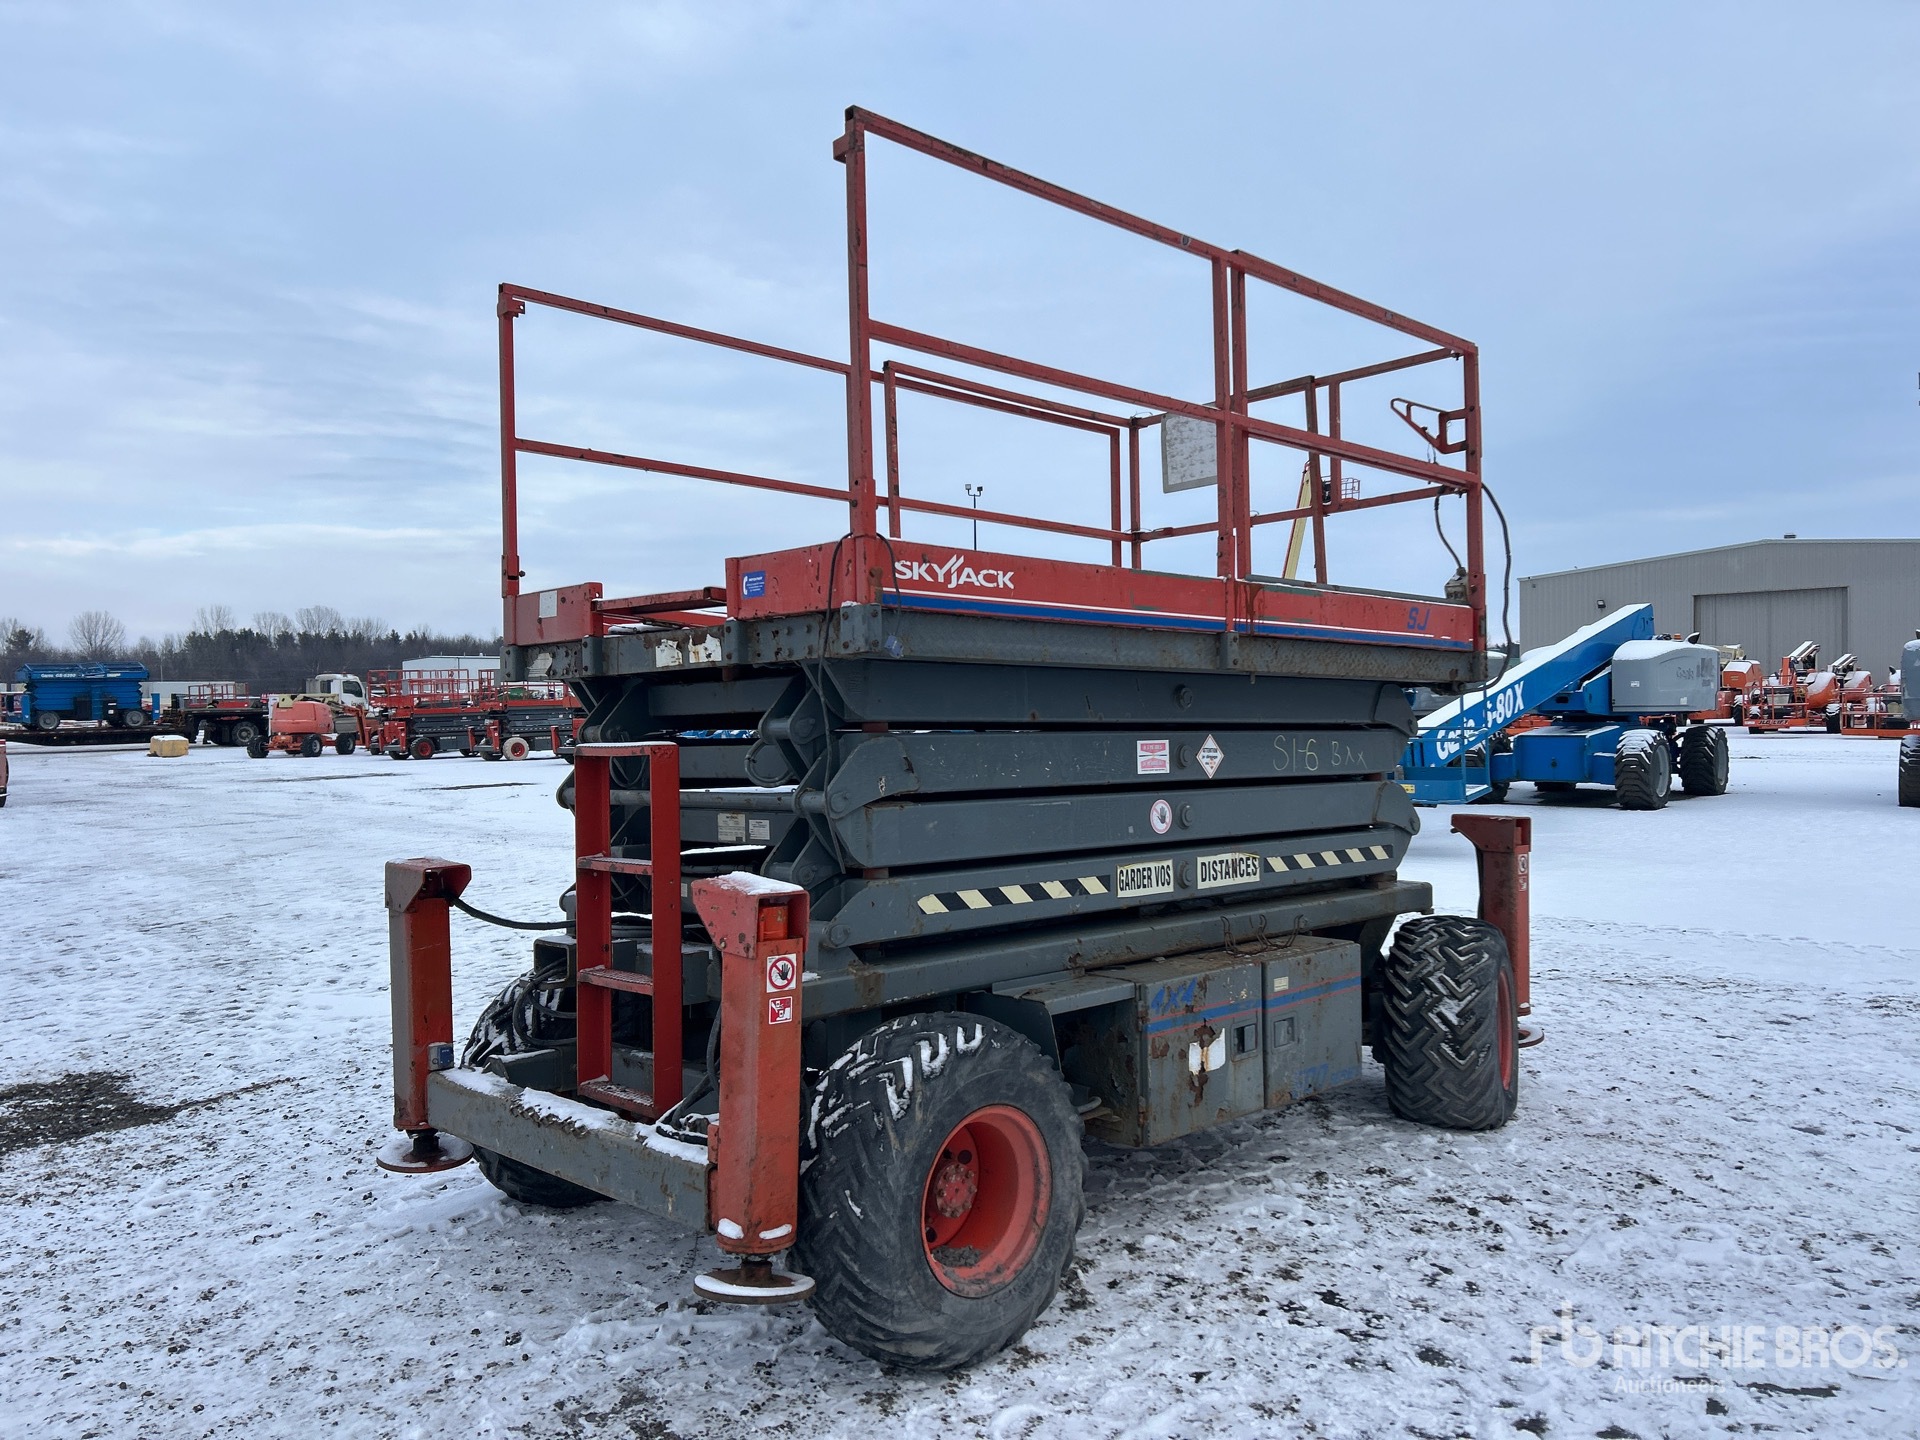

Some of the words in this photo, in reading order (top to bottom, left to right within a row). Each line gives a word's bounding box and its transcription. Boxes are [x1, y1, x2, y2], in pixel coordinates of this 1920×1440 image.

[894, 554, 1014, 589] SKYJACK
[1118, 866, 1153, 892] GARDER
[1154, 864, 1171, 888] VOS
[1200, 856, 1258, 883] DISTANCES
